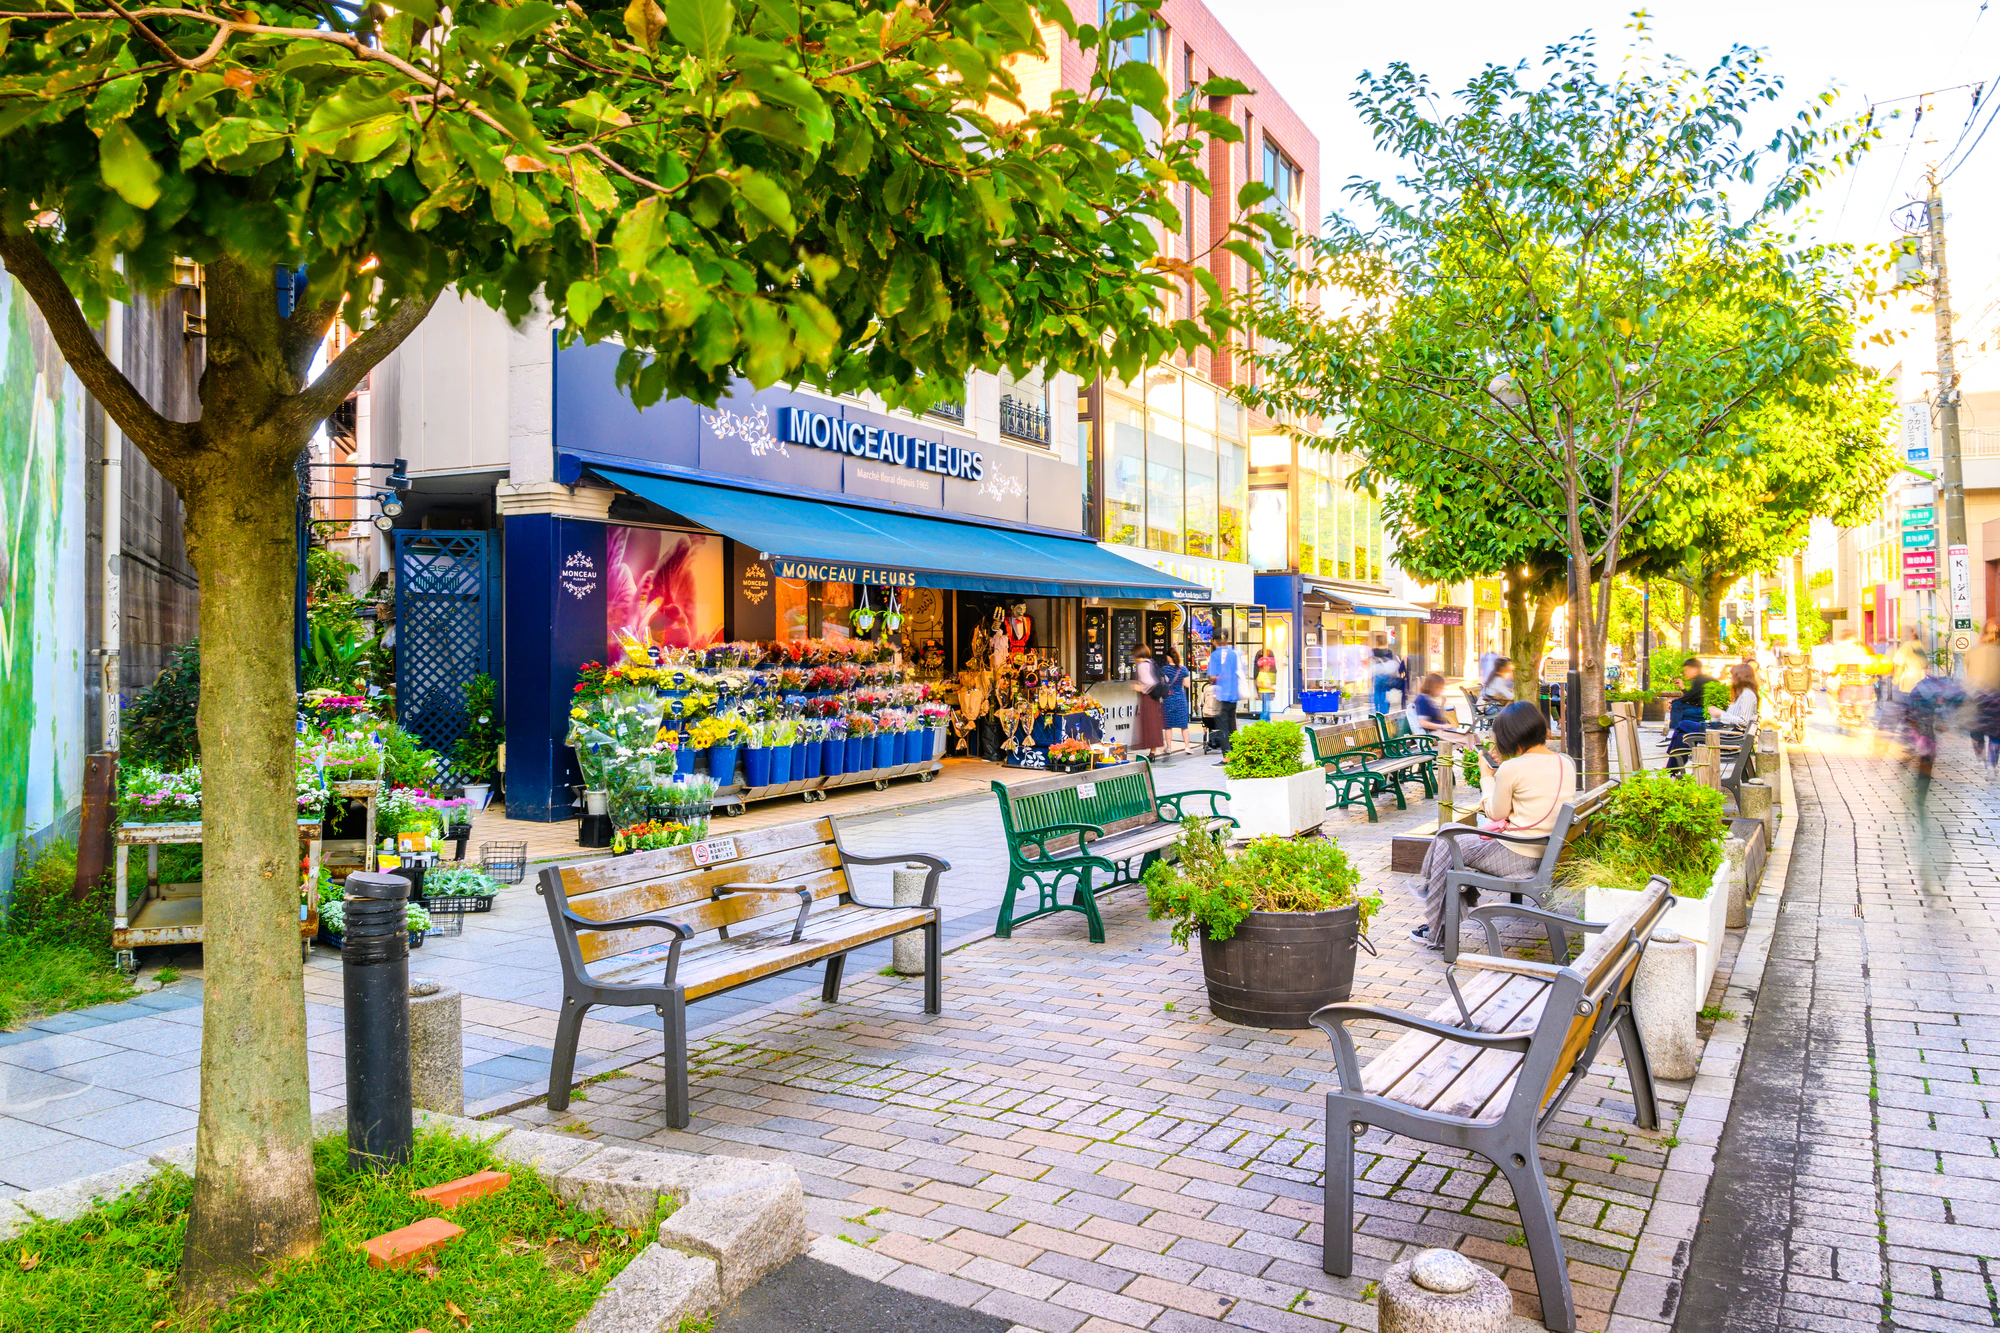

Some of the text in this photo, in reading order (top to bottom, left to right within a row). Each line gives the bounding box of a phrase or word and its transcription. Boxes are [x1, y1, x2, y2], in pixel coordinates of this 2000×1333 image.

[790, 407, 985, 481] MONCEAU FLEURS
[1907, 418, 1916, 449] クリニック
[856, 467, 929, 491] Marché floral depuis 1965
[562, 570, 597, 578] MONCEAU
[742, 579, 769, 587] MONCEAU
[782, 562, 916, 587] MONCEAU FLEURS
